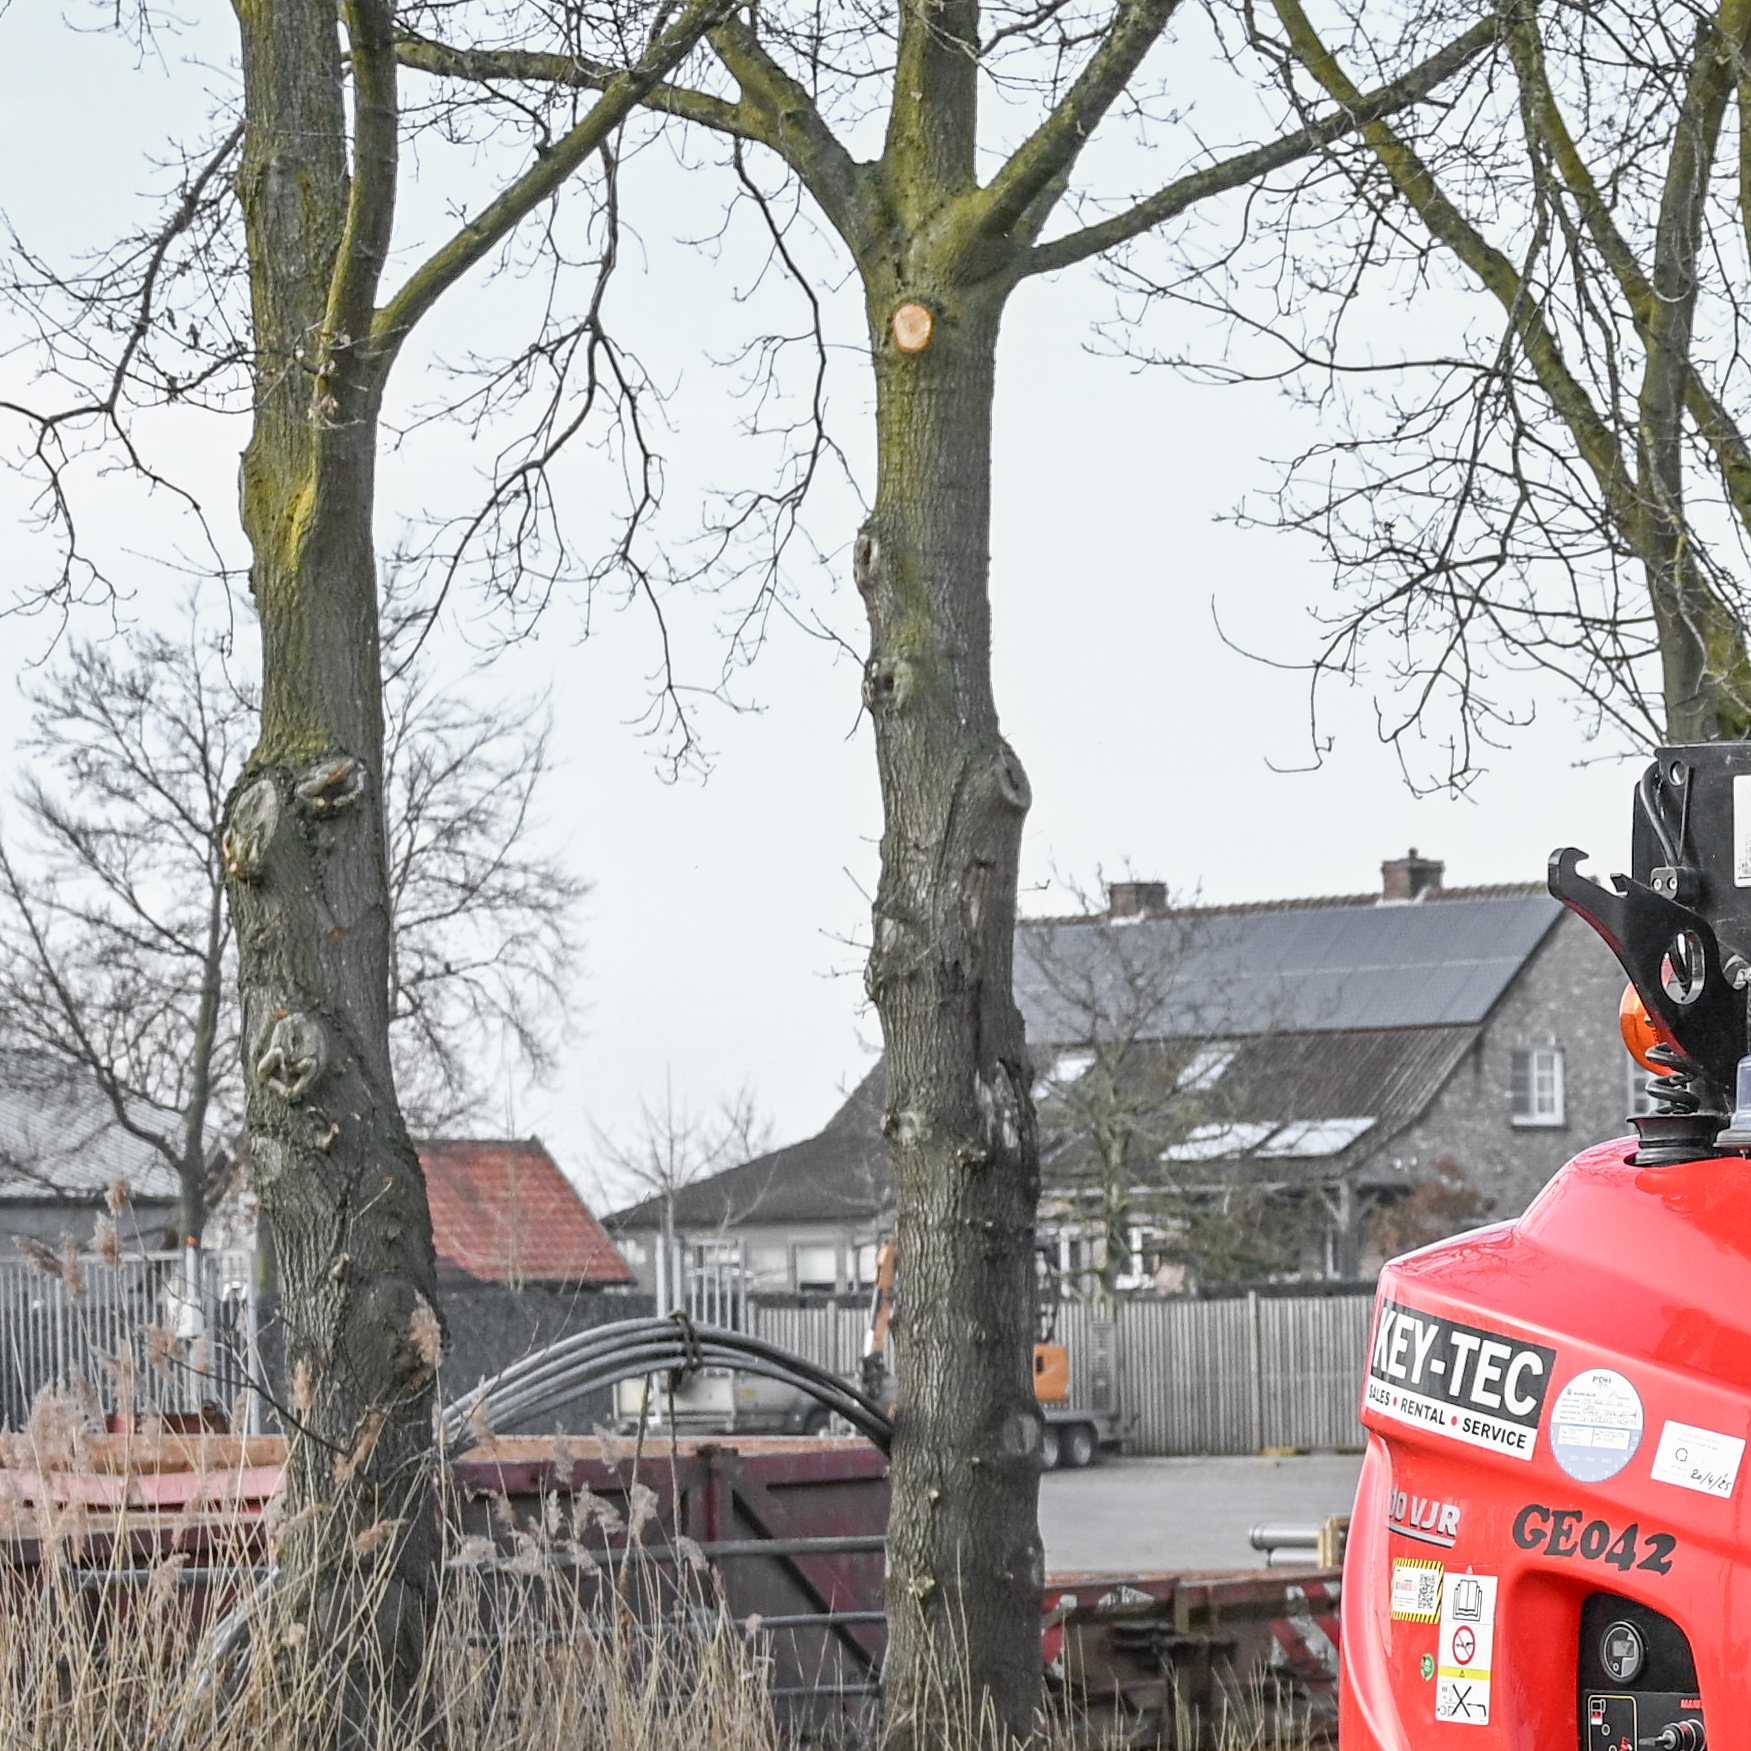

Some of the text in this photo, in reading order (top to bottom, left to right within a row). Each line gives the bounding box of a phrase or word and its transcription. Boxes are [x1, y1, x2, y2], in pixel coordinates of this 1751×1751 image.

[1372, 1306, 1545, 1417] KEY-TEC
[1368, 1383, 1391, 1407] SALES
[1400, 1399, 1446, 1426] RENTAL
[1462, 1417, 1527, 1450] SERVICE
[1410, 1495, 1461, 1537] VJR
[1512, 1503, 1677, 1575] GE042
